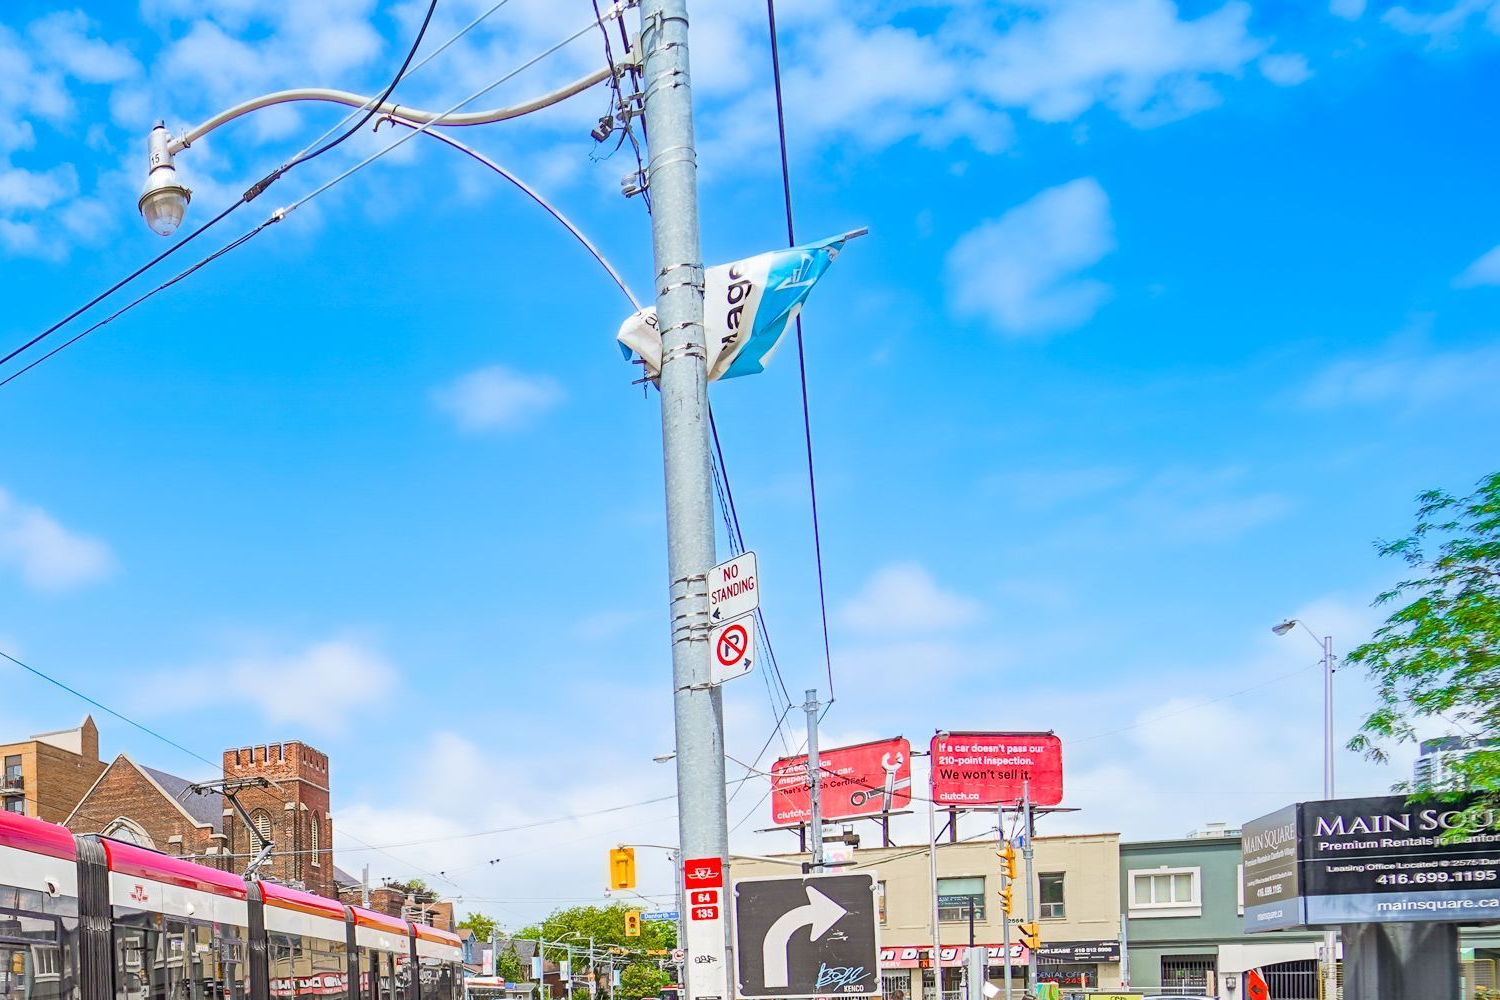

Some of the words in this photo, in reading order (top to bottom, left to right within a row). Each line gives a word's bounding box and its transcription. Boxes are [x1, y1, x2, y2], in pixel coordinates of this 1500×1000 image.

[724, 564, 739, 582] NO
[712, 576, 755, 605] STANDING
[1007, 746, 1027, 754] pass
[939, 756, 982, 766] 210-point
[984, 756, 1034, 766] inspection.
[940, 769, 959, 779] We
[962, 769, 995, 779] won't
[998, 769, 1017, 779] sell
[1020, 769, 1032, 779] it.
[940, 791, 979, 800] clutch.ca
[778, 809, 811, 820] clutch.c
[1313, 813, 1411, 837] MAIN
[1244, 834, 1263, 855] MAIN
[1264, 823, 1295, 850] SQUARE
[1319, 841, 1378, 851] Premium
[1380, 836, 1433, 848] Rentals
[1326, 865, 1365, 873] Leasing
[1396, 862, 1438, 870] Located
[1376, 870, 1497, 885] 416.699.1195
[698, 893, 710, 903] 64
[1377, 898, 1499, 911] mainsquare.ca
[696, 909, 714, 919] 135
